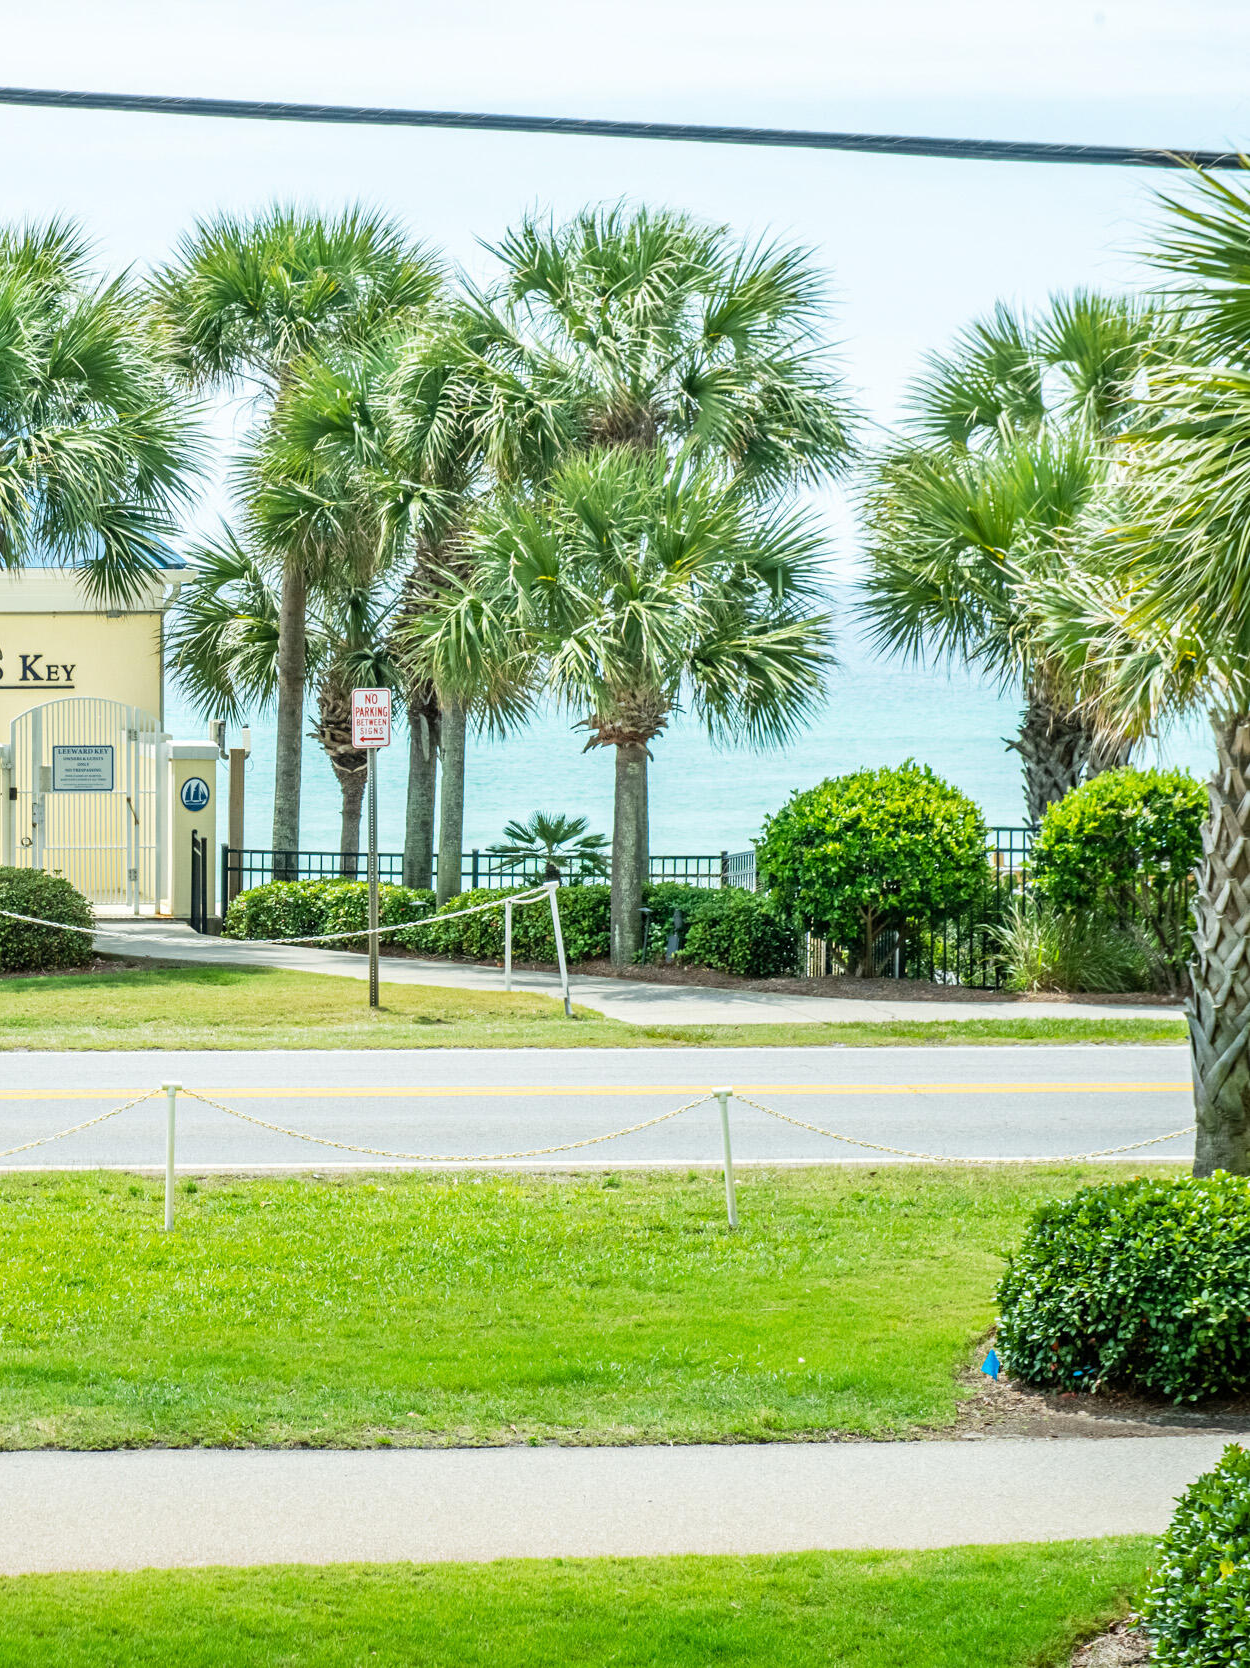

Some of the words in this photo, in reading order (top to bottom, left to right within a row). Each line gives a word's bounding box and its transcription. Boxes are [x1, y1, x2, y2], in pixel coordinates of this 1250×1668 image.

[19, 654, 76, 682] KEY
[364, 693, 378, 705] NO
[355, 706, 388, 717] PARKING
[356, 718, 387, 727] BETWEEN
[360, 727, 384, 735] SIGNS
